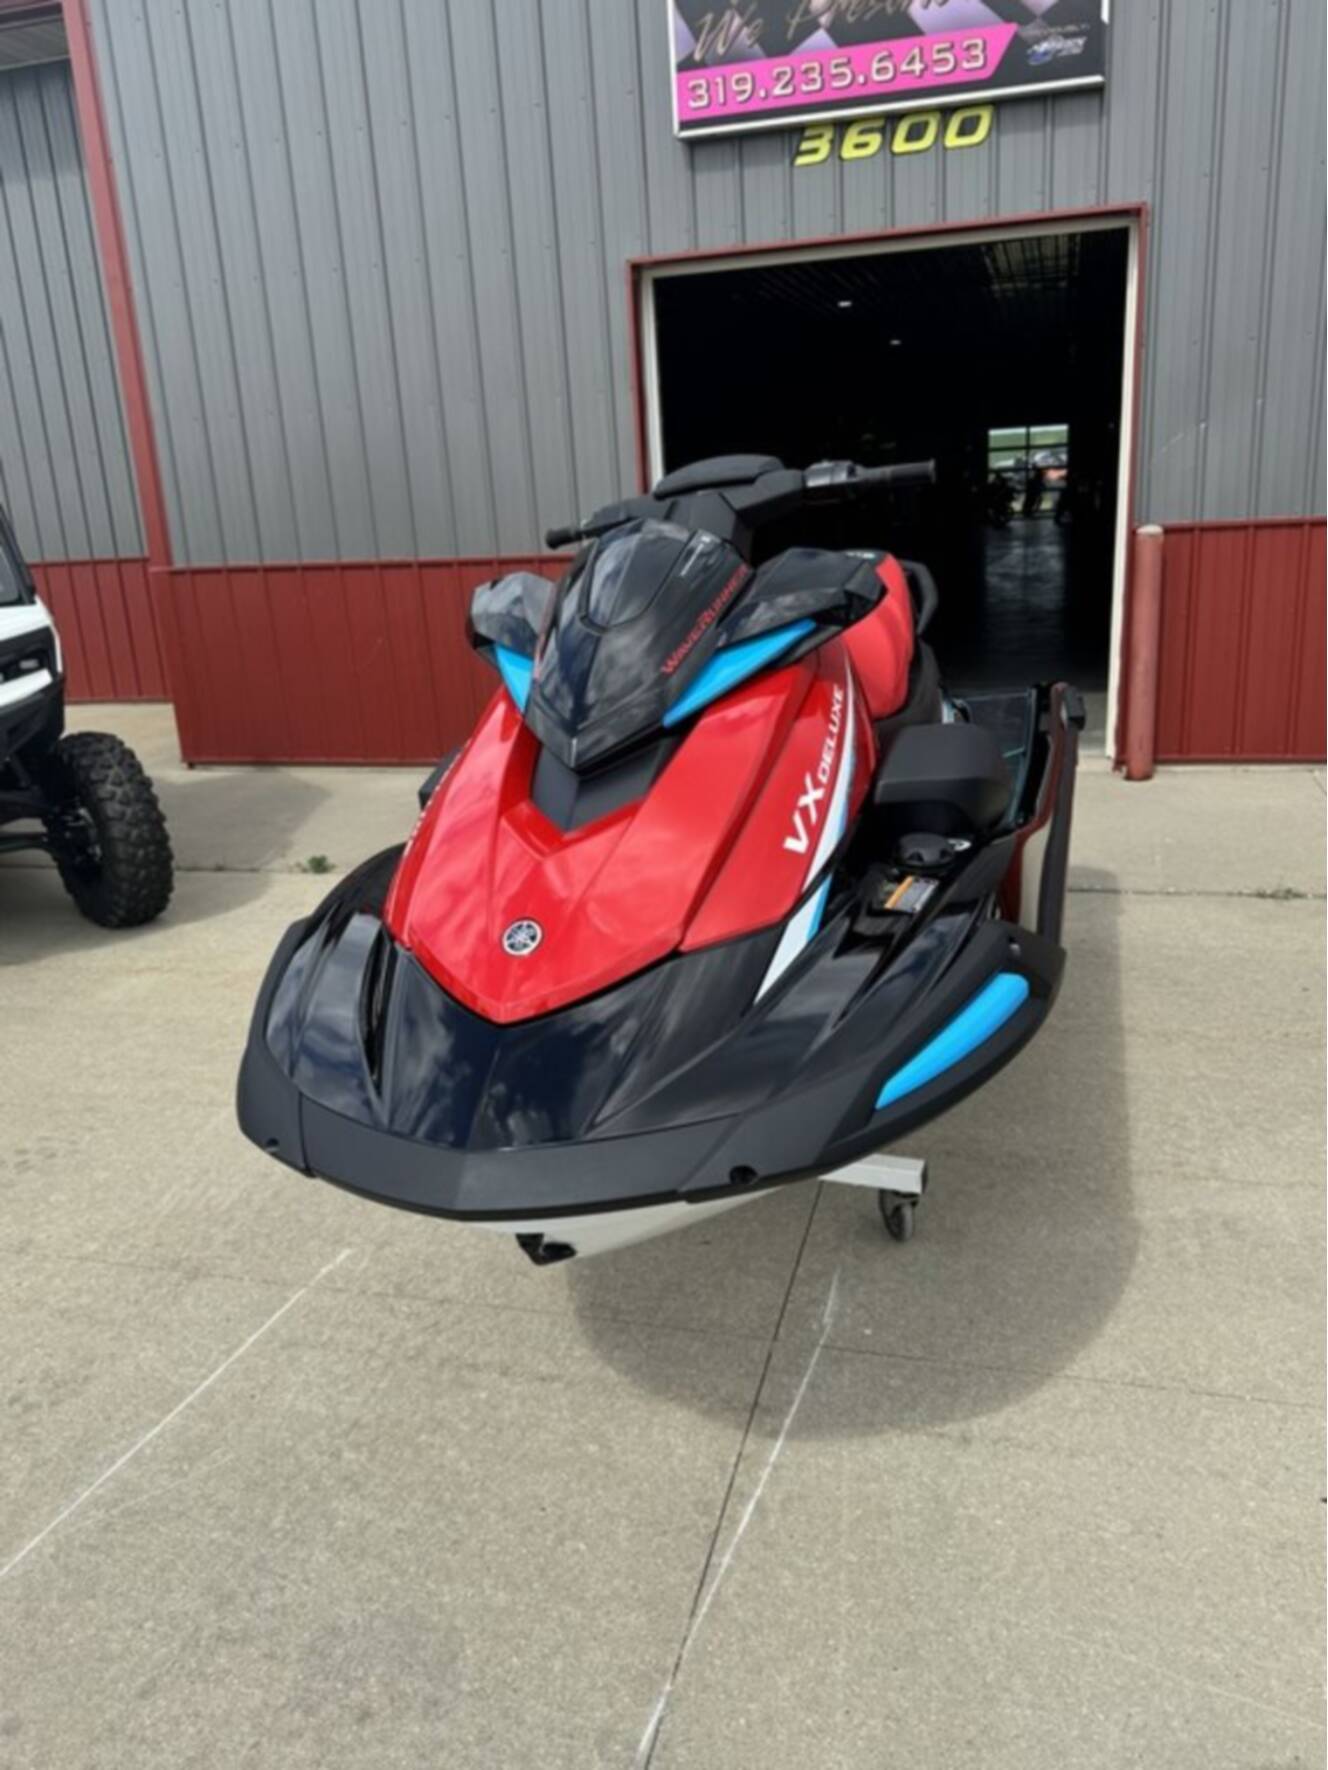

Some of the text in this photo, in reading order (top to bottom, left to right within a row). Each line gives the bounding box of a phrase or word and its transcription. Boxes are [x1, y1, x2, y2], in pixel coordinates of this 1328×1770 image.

[693, 3, 762, 61] We
[687, 38, 987, 110] 319.235.6453
[793, 104, 995, 167] 3600
[782, 683, 844, 855] VX DELUXE
